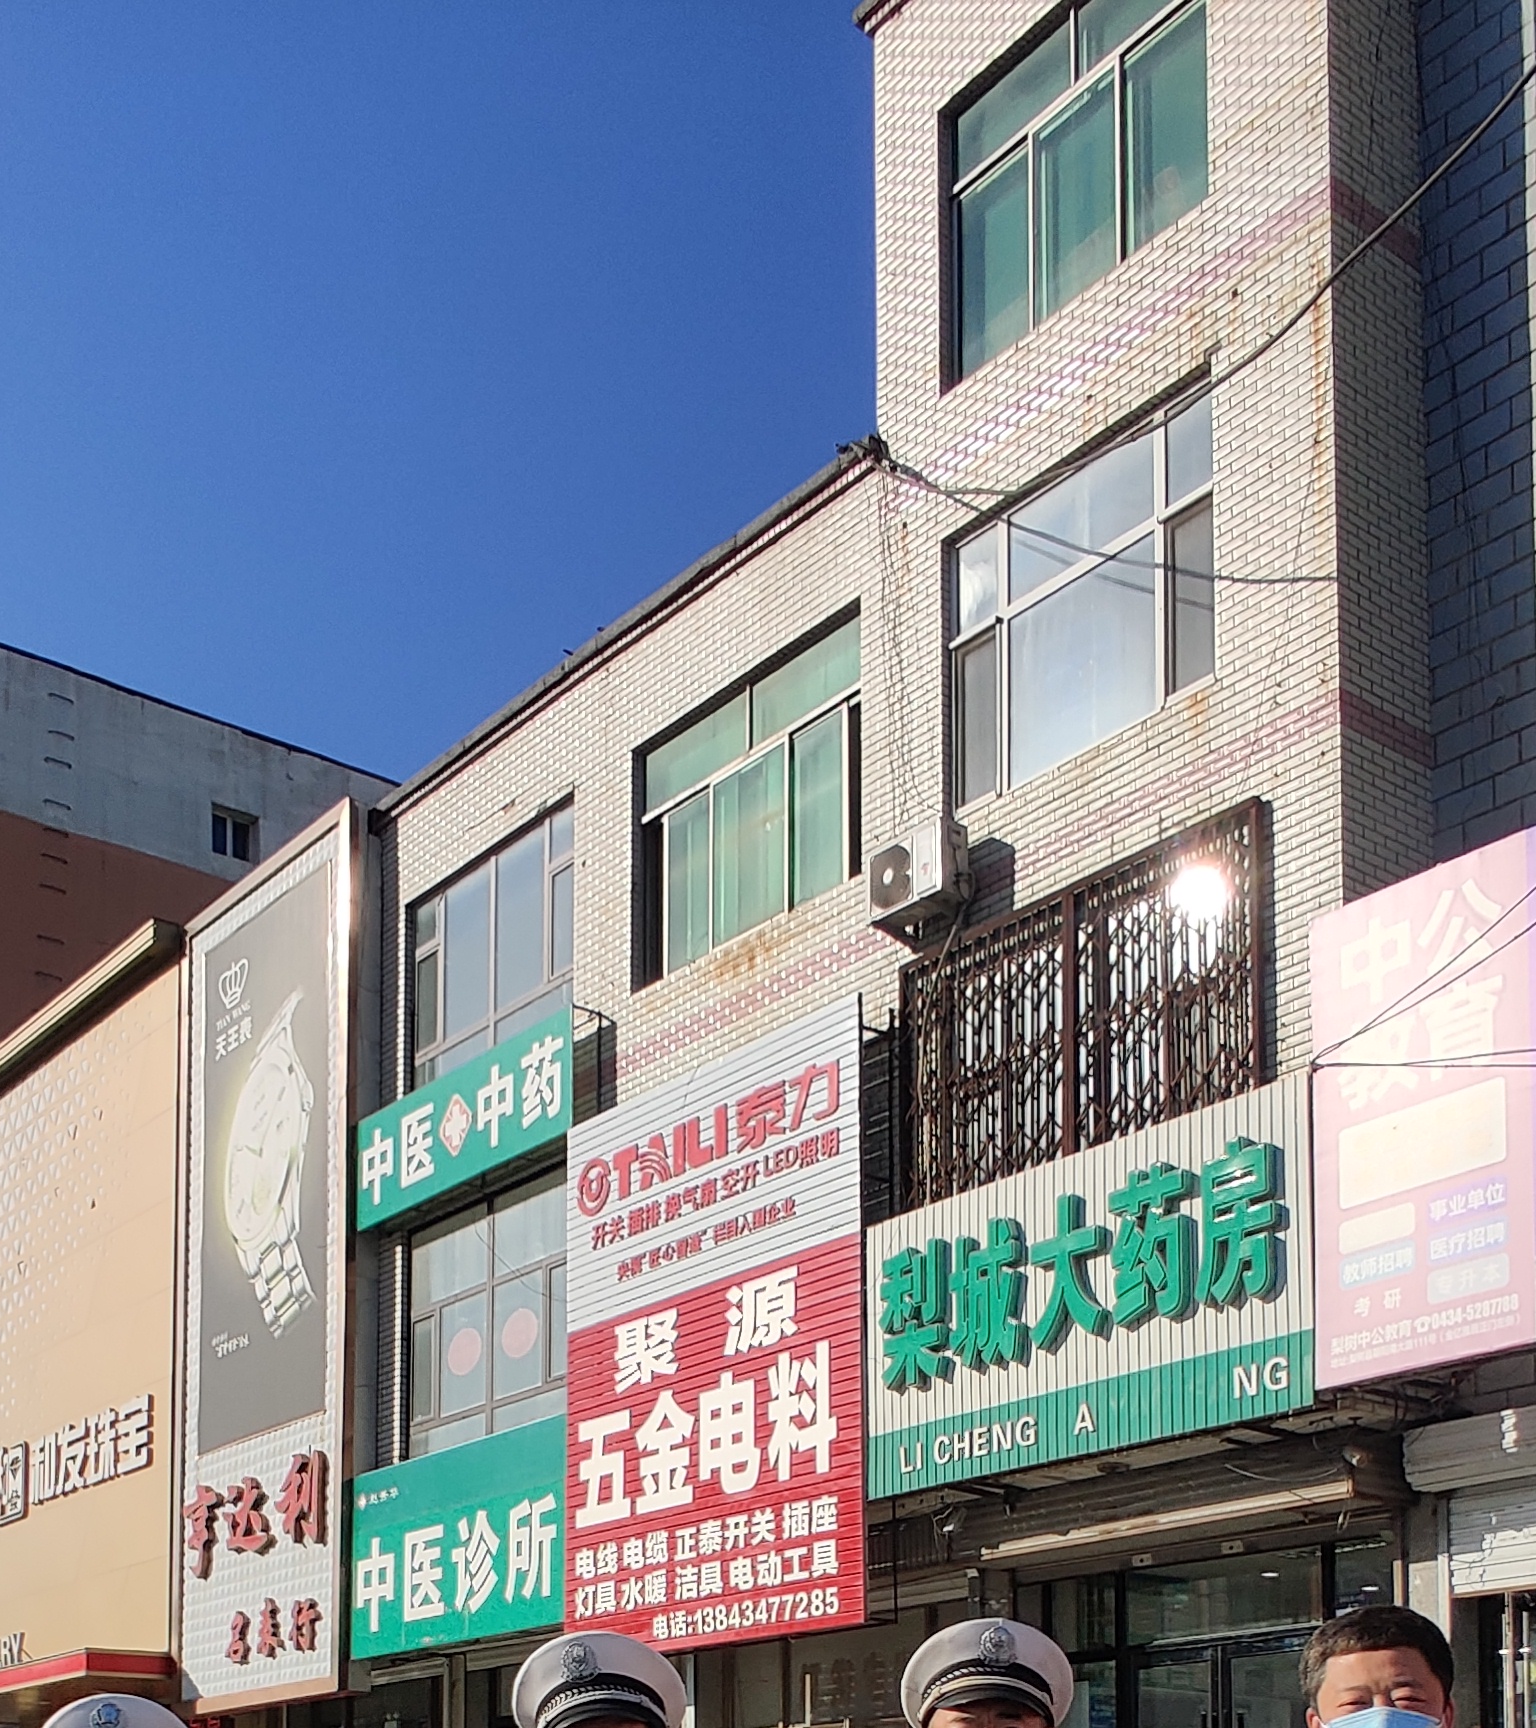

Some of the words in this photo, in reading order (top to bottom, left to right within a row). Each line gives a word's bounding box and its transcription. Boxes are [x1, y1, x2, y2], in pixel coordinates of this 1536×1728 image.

[1341, 878, 1503, 1004] 中公
[215, 1016, 252, 1061] 天王表
[1337, 974, 1503, 1111] 教育
[362, 1102, 435, 1205] 中医
[477, 1035, 564, 1149] 中药
[613, 1103, 728, 1200] TAILI
[736, 1059, 840, 1154] 泰力
[591, 1215, 624, 1251] 开关
[665, 1178, 718, 1221] 换气扇
[721, 1160, 760, 1200] 空开
[763, 1127, 841, 1177] LED照明
[1428, 1182, 1506, 1222] 事业单位
[879, 1135, 1287, 1395] 梨城大药房
[1342, 1247, 1413, 1285] 教师招聘
[1429, 1222, 1505, 1261] 医疗招聘
[1353, 1287, 1402, 1318] 考研
[614, 1265, 800, 1394] 聚源
[1330, 1319, 1413, 1356] 梨树中公教育
[31, 1393, 154, 1506] 和发珠宝
[575, 1341, 839, 1528] 五金电料
[899, 1441, 924, 1474] LI
[933, 1416, 1037, 1464] CHENG
[1073, 1403, 1096, 1438] A
[1232, 1356, 1290, 1400] NG
[183, 1449, 330, 1582] 亨达利
[356, 1492, 558, 1634] 中医诊所
[574, 1541, 620, 1580] 电线
[622, 1530, 669, 1570] 电缆
[673, 1507, 776, 1561] 正泰开关
[782, 1495, 839, 1541] 插座
[574, 1580, 617, 1620] 灯具
[620, 1569, 668, 1612] 水暖
[674, 1560, 724, 1601] 洁具
[728, 1538, 839, 1592] 电动工具
[652, 1587, 839, 1640] 电话:13843477285
